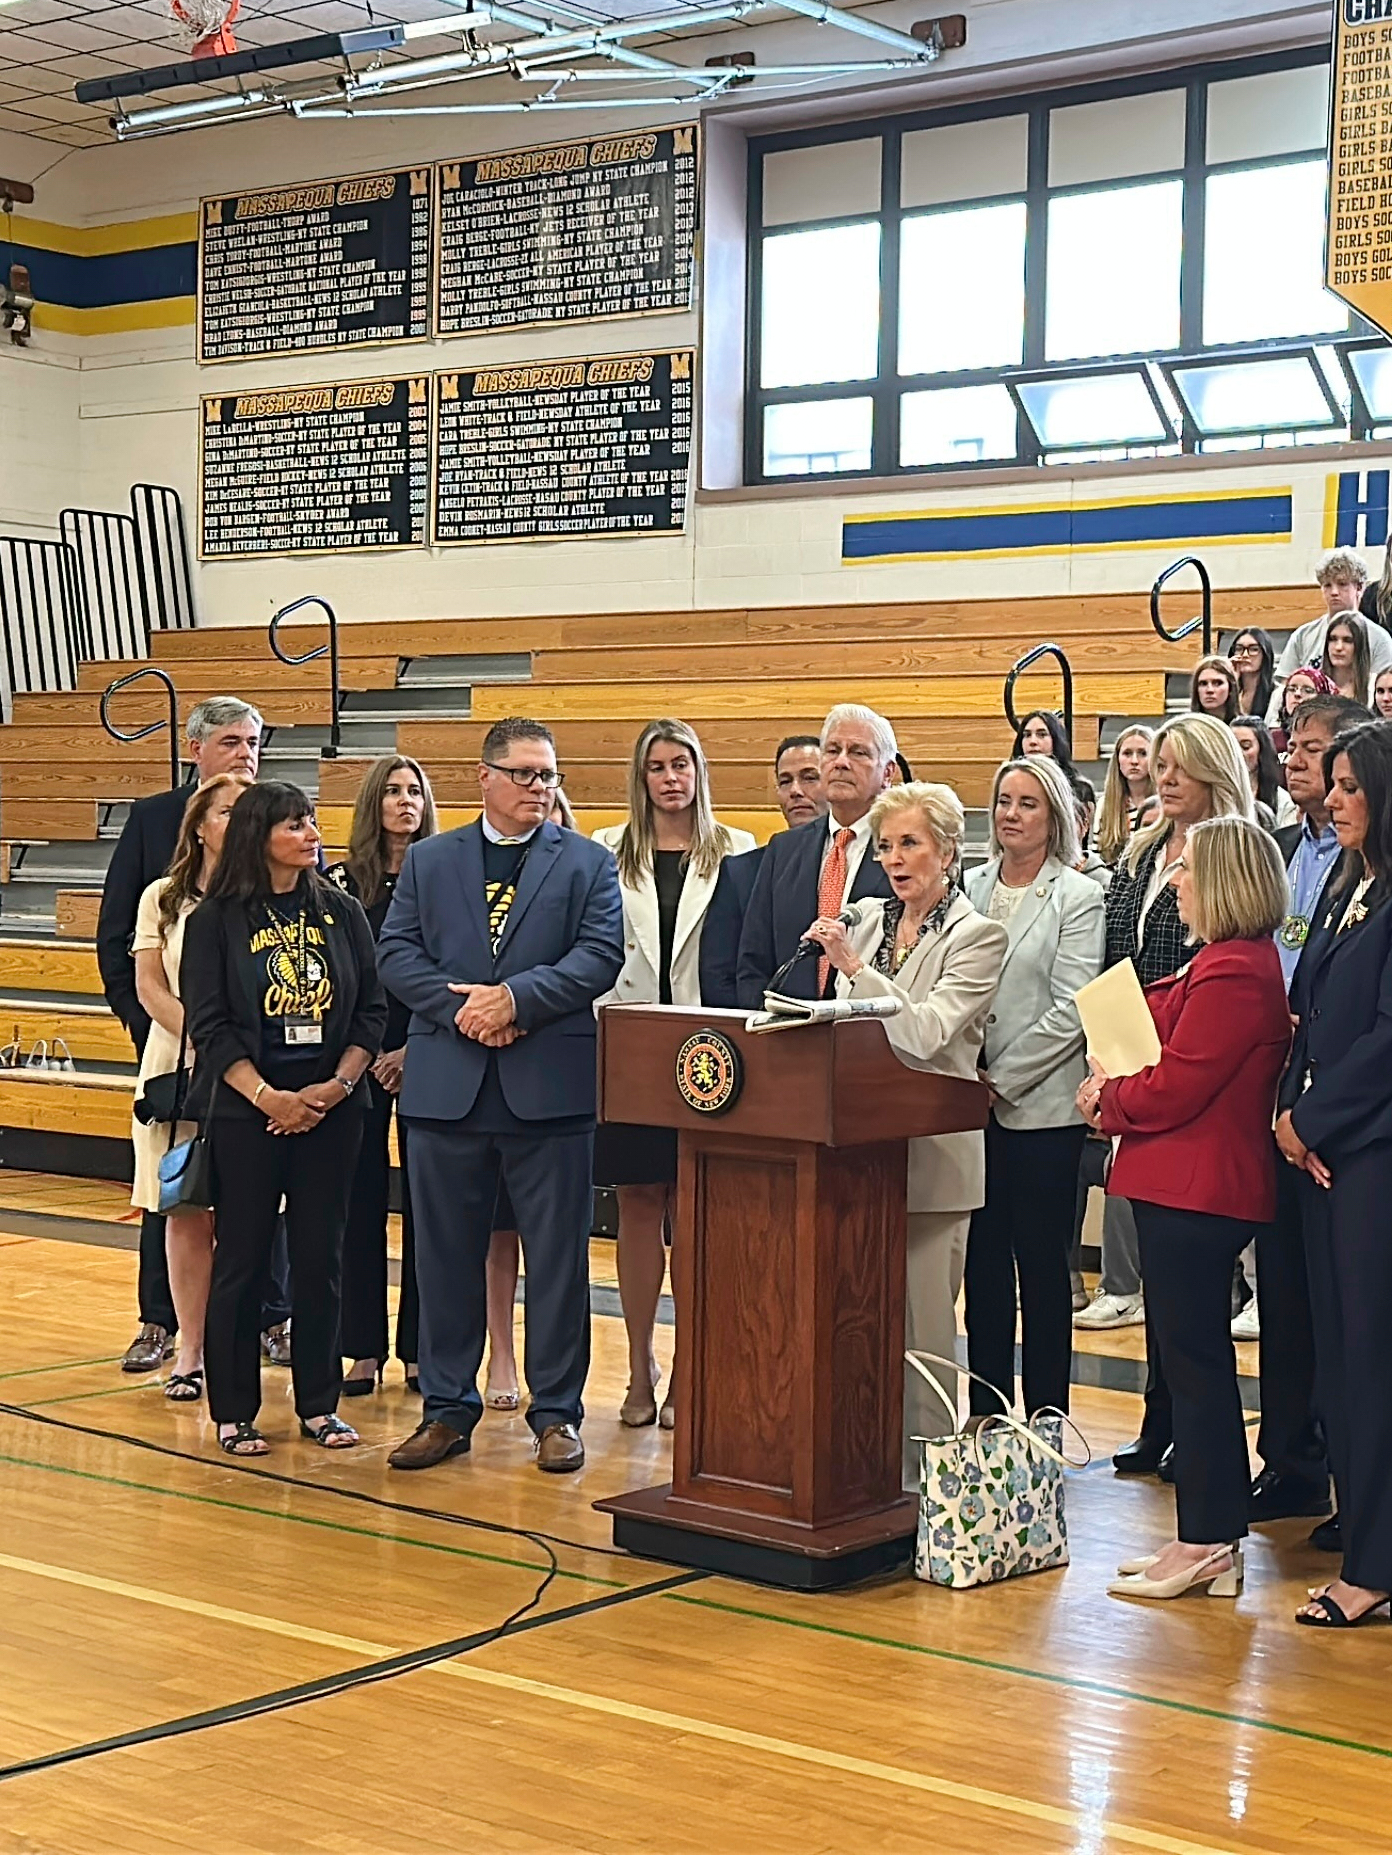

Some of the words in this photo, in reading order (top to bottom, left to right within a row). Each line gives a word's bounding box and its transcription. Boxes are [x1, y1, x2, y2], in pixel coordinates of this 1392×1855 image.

[1344, 32, 1375, 49] BOYS
[1341, 104, 1376, 121] GIRLS
[1340, 122, 1375, 140] GIRLS
[442, 165, 460, 189] M
[475, 145, 587, 183] MASSAPEQUA
[590, 134, 656, 166] CHIEFS
[673, 127, 693, 155] M
[1339, 141, 1375, 158] GIRLS
[1339, 159, 1374, 176] GIRLS
[206, 201, 222, 225] M
[235, 185, 335, 219] MASSAPEQUA
[337, 176, 396, 205] CHIEFS
[410, 171, 428, 195] M
[576, 199, 611, 213] SCHOLAR
[613, 193, 649, 207] ATHLETE
[674, 187, 694, 200] 2012
[1337, 197, 1375, 213] FIELD
[309, 225, 331, 237] STATE
[1337, 215, 1369, 230] BOYS
[1336, 233, 1372, 248] GIRLS
[1335, 252, 1367, 266] BOYS
[1334, 270, 1366, 285] BOYS
[441, 375, 458, 399] M
[473, 368, 584, 396] MASSAPEQUA
[587, 357, 654, 387] CHIEFS
[670, 354, 690, 379] M
[206, 400, 221, 422] M
[235, 388, 332, 419] MASSAPEQUA
[335, 383, 394, 408] CHIEFS
[408, 380, 426, 403] M
[570, 391, 598, 403] PLAYER
[611, 387, 627, 399] THE
[629, 385, 650, 397] YEAR
[672, 382, 691, 394] 2015
